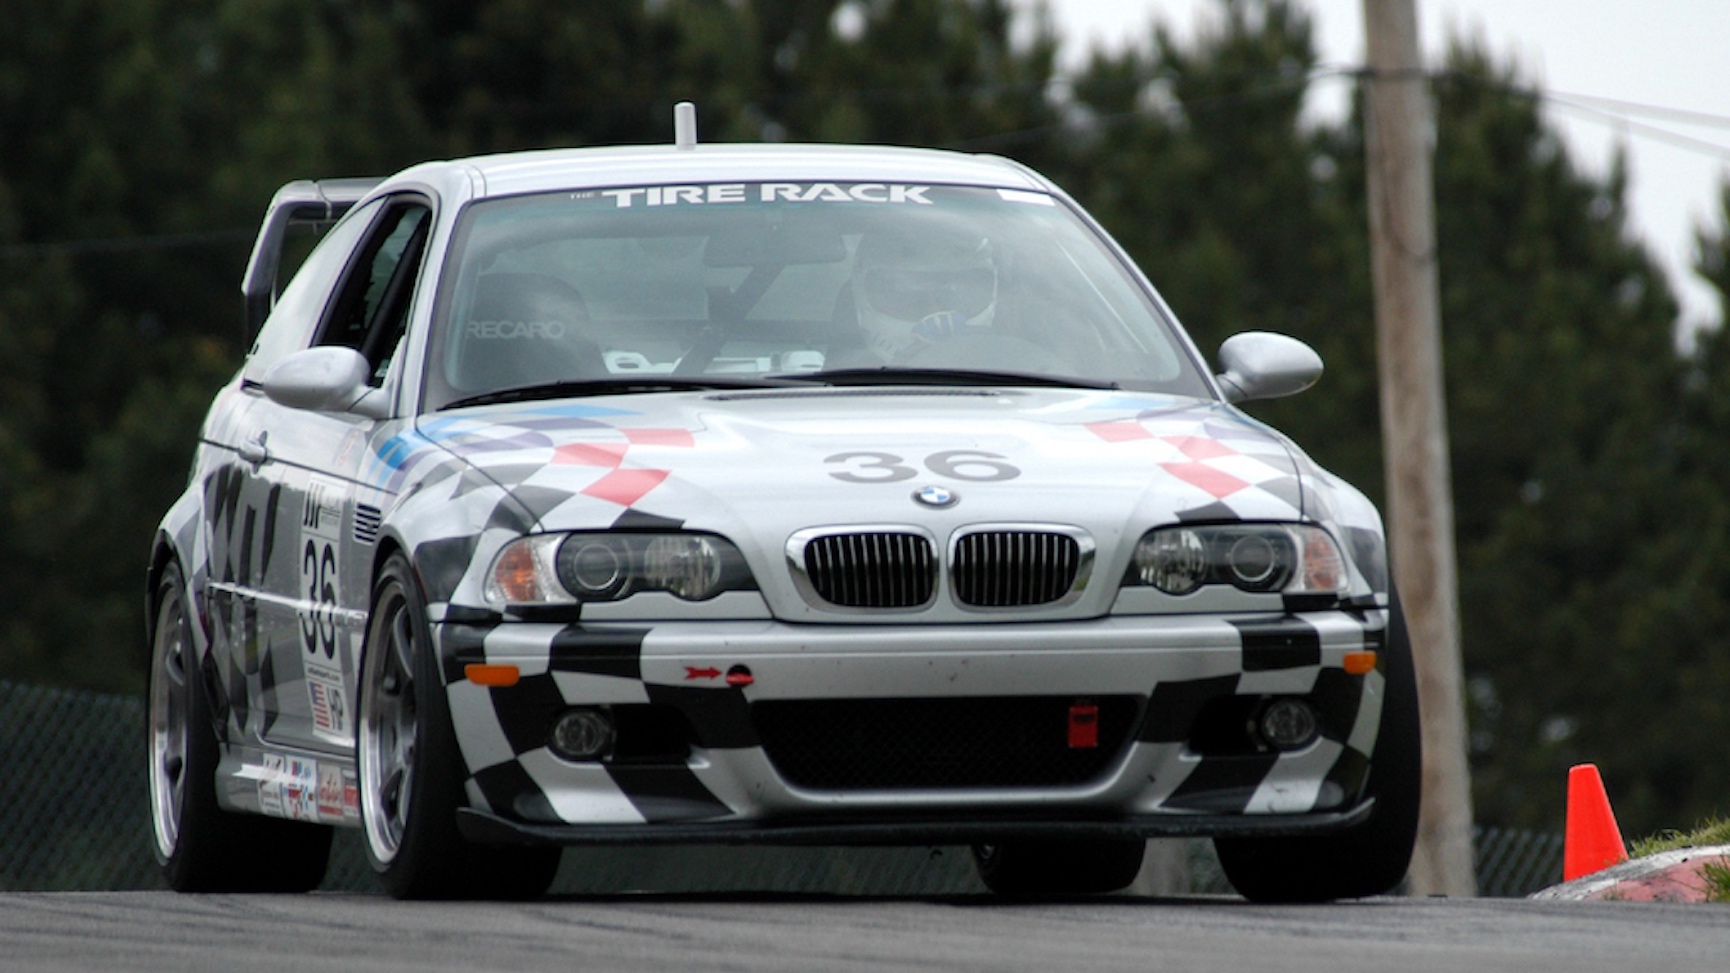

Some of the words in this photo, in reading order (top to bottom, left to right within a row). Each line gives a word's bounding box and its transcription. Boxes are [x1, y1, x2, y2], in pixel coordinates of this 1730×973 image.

[601, 183, 746, 208] TIRE
[760, 183, 933, 205] RACK
[466, 320, 565, 340] RECARO
[823, 450, 1022, 484] 36
[299, 539, 336, 660] 36
